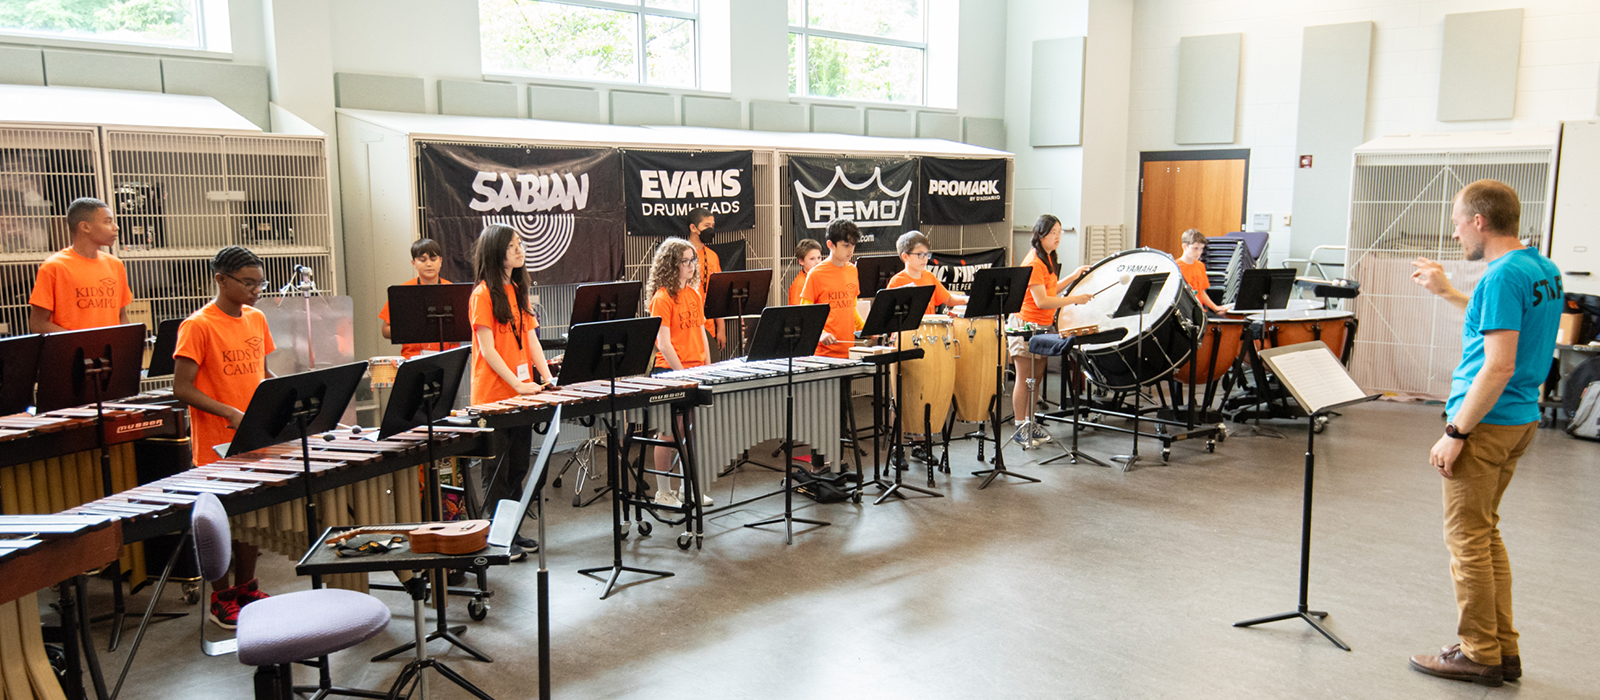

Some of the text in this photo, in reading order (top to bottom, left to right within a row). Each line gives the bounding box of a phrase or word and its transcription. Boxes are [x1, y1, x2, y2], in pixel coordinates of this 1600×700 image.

[640, 169, 741, 199] EVANS
[928, 179, 1000, 196] PROMARK
[468, 171, 590, 212] SABIAN
[814, 200, 896, 221] REMO
[953, 263, 993, 283] FIR
[1125, 264, 1158, 274] YAMAHA
[76, 287, 104, 298] KIDS
[948, 283, 959, 291] THE
[828, 291, 849, 300] KIDS
[76, 298, 117, 309] CAMPU
[222, 349, 251, 362] KIDS
[223, 361, 263, 376] CAMPU
